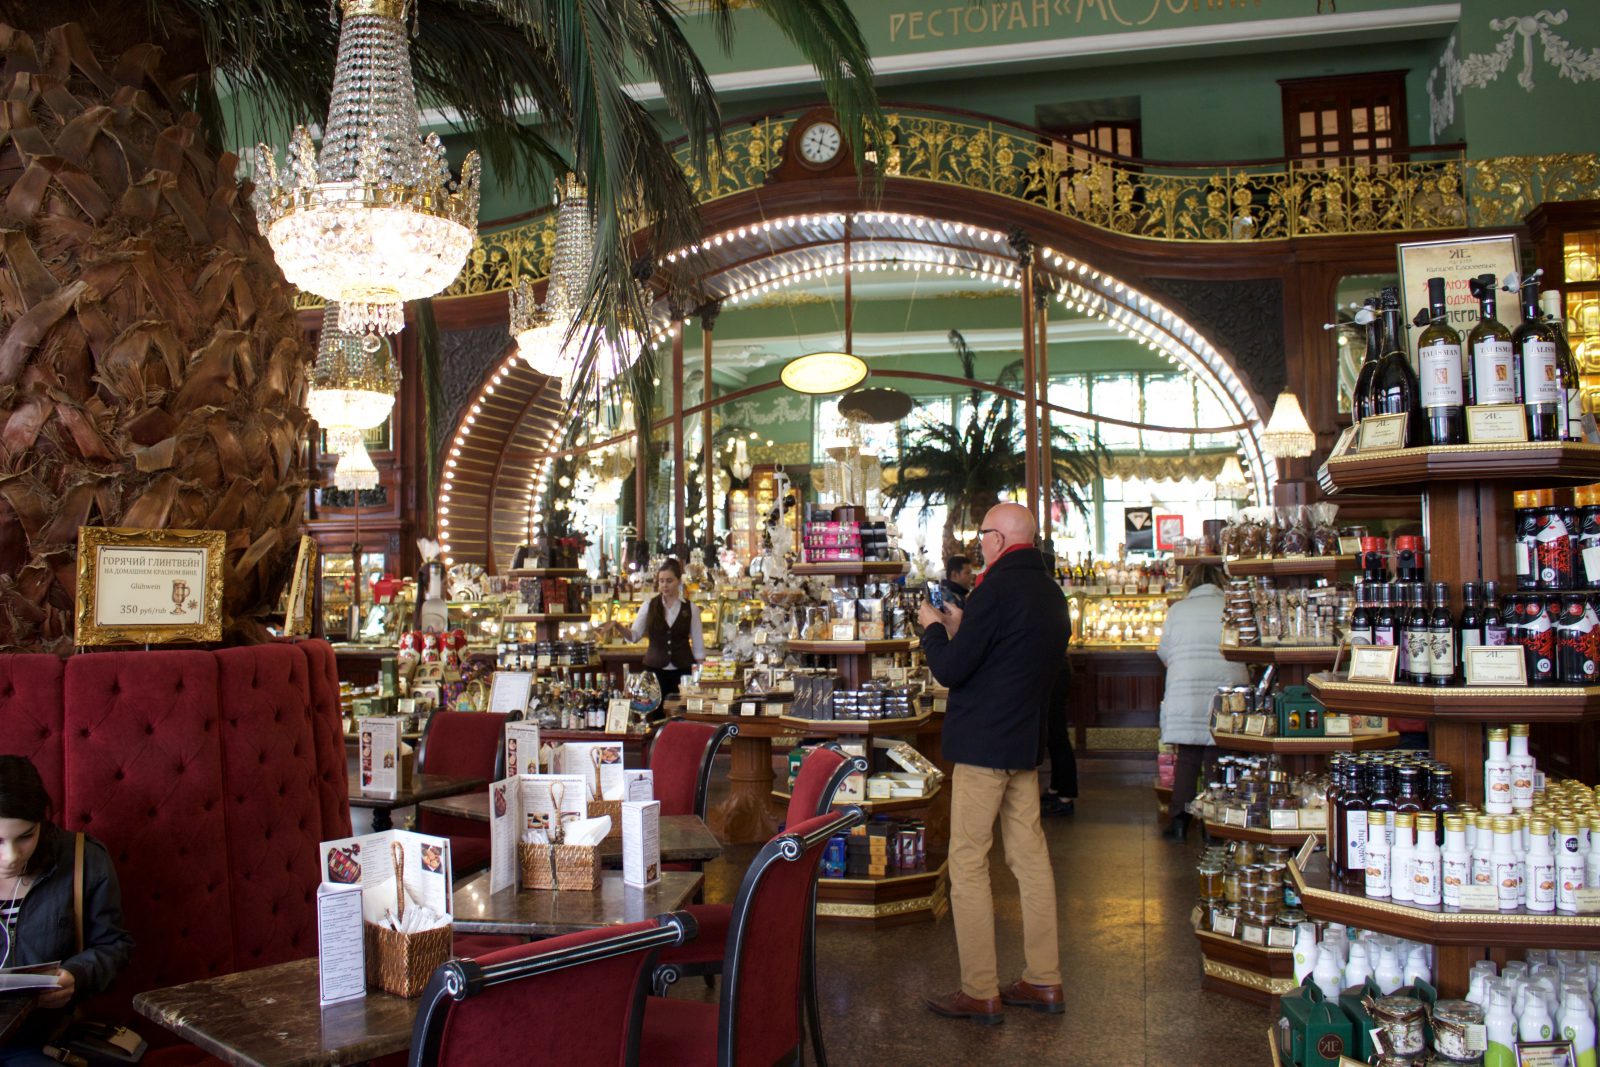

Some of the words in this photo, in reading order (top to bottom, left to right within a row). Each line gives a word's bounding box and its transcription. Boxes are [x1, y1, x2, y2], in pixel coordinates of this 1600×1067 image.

[1422, 349, 1458, 358] TALISMAN
[103, 556, 146, 566] ГОРЯЧИЙ
[148, 557, 200, 567] ГЛИНТВЕЙН
[130, 582, 161, 590] Glühwein
[120, 605, 138, 614] 350
[139, 607, 167, 615] руб/rub
